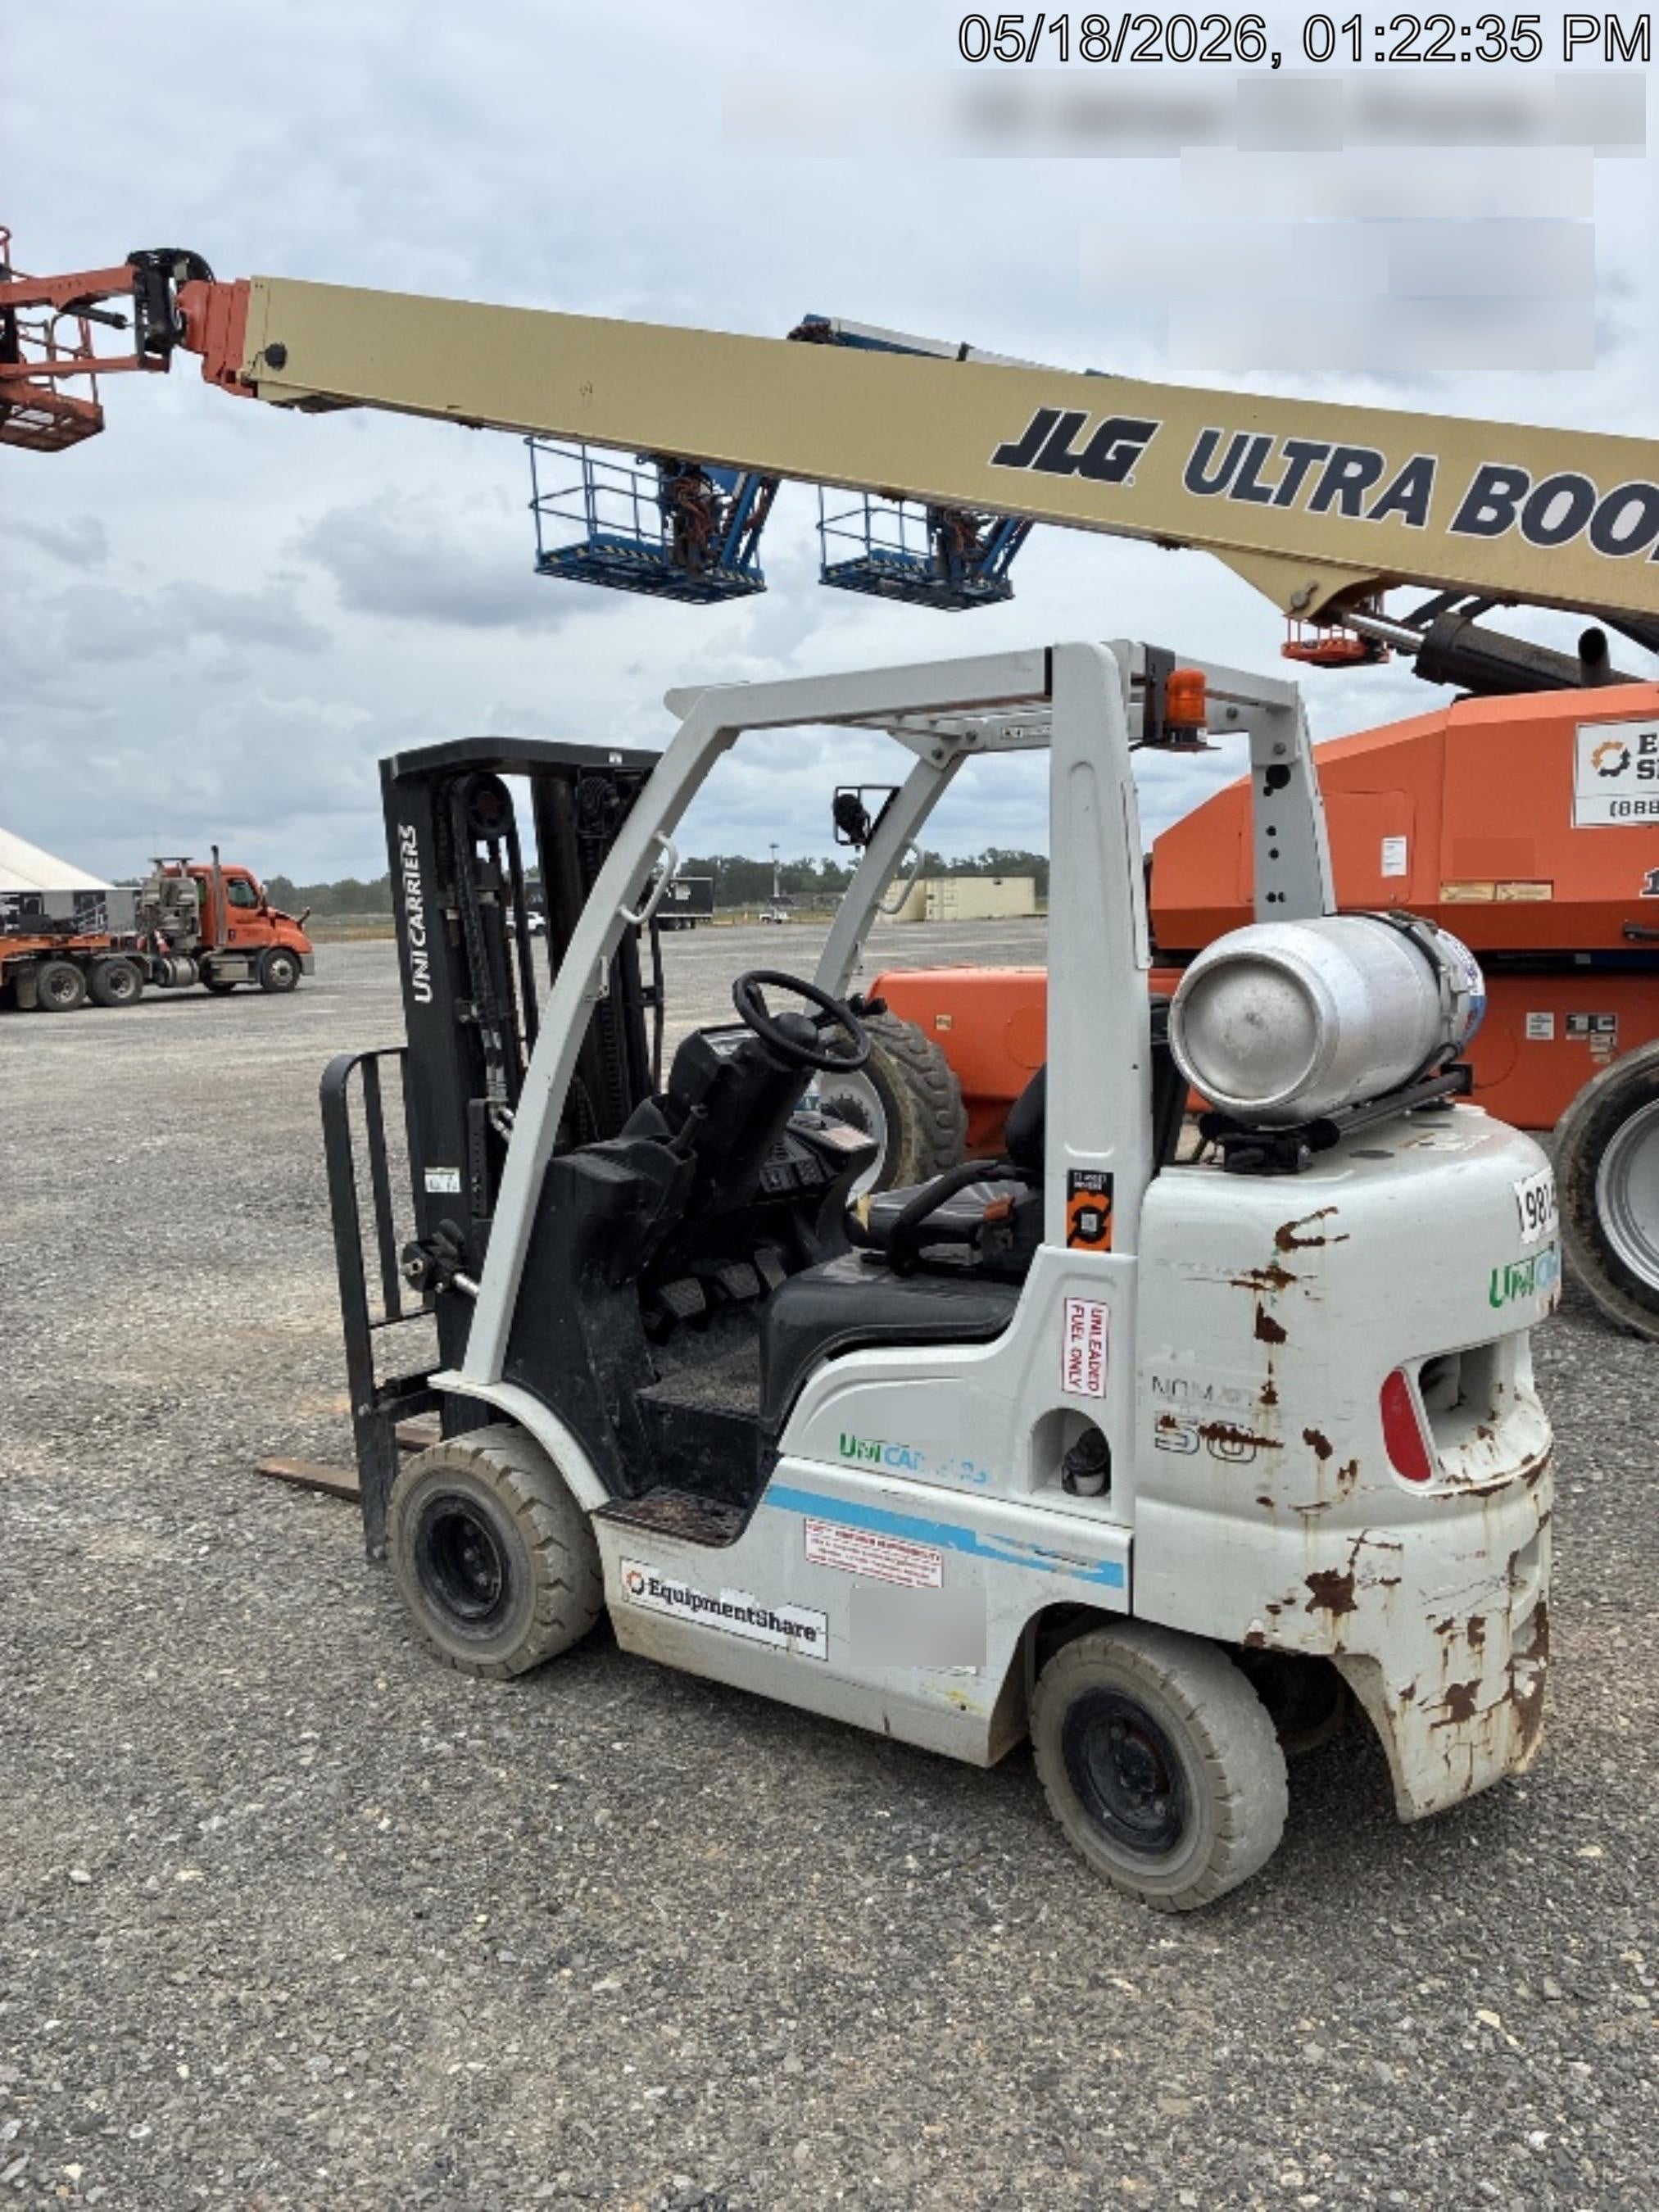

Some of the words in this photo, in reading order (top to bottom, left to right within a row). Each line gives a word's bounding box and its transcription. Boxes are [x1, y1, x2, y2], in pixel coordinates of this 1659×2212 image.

[988, 407, 1164, 487] JLG
[1182, 427, 1439, 531] ULTRA
[1445, 462, 1659, 564] BOO
[397, 823, 433, 1003] UNICARRIERS
[1071, 1304, 1085, 1343] FUEL
[1088, 1306, 1104, 1392] UNLEADED
[1068, 1347, 1082, 1389] ONLY
[648, 1576, 818, 1643] EquipmentShare
